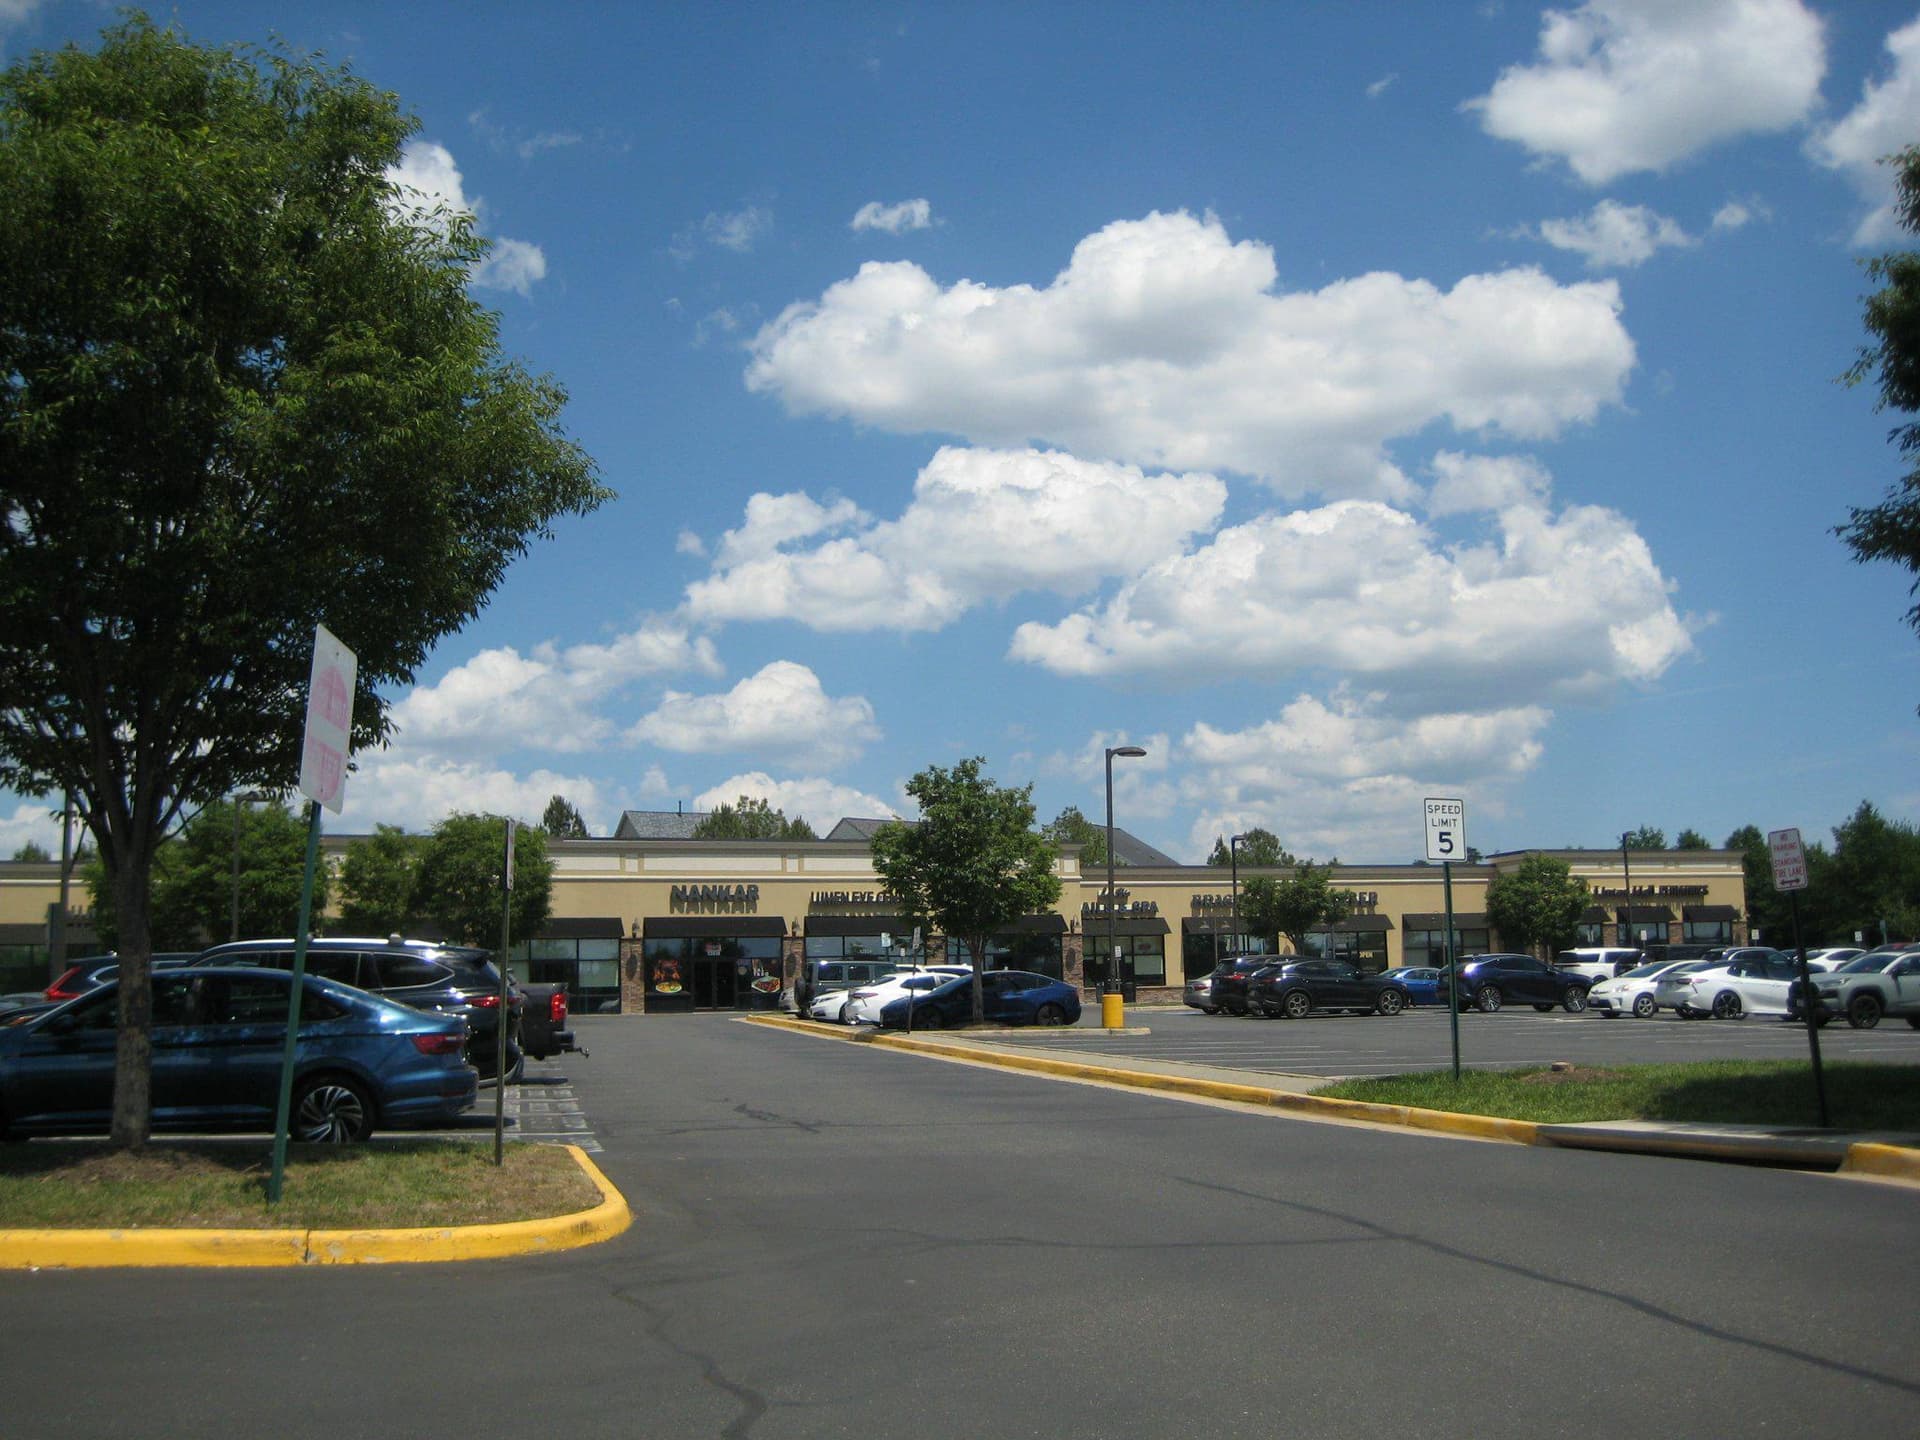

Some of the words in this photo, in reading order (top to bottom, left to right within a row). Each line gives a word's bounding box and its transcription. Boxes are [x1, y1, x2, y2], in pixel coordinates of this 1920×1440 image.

[1427, 804, 1461, 815] SPEED
[1431, 818, 1457, 828] LIMIT
[1438, 831, 1454, 854] 5
[671, 884, 760, 901] NANKAR
[852, 891, 876, 904] EYE
[1082, 901, 1113, 913] AILS
[1132, 900, 1159, 913] SPA
